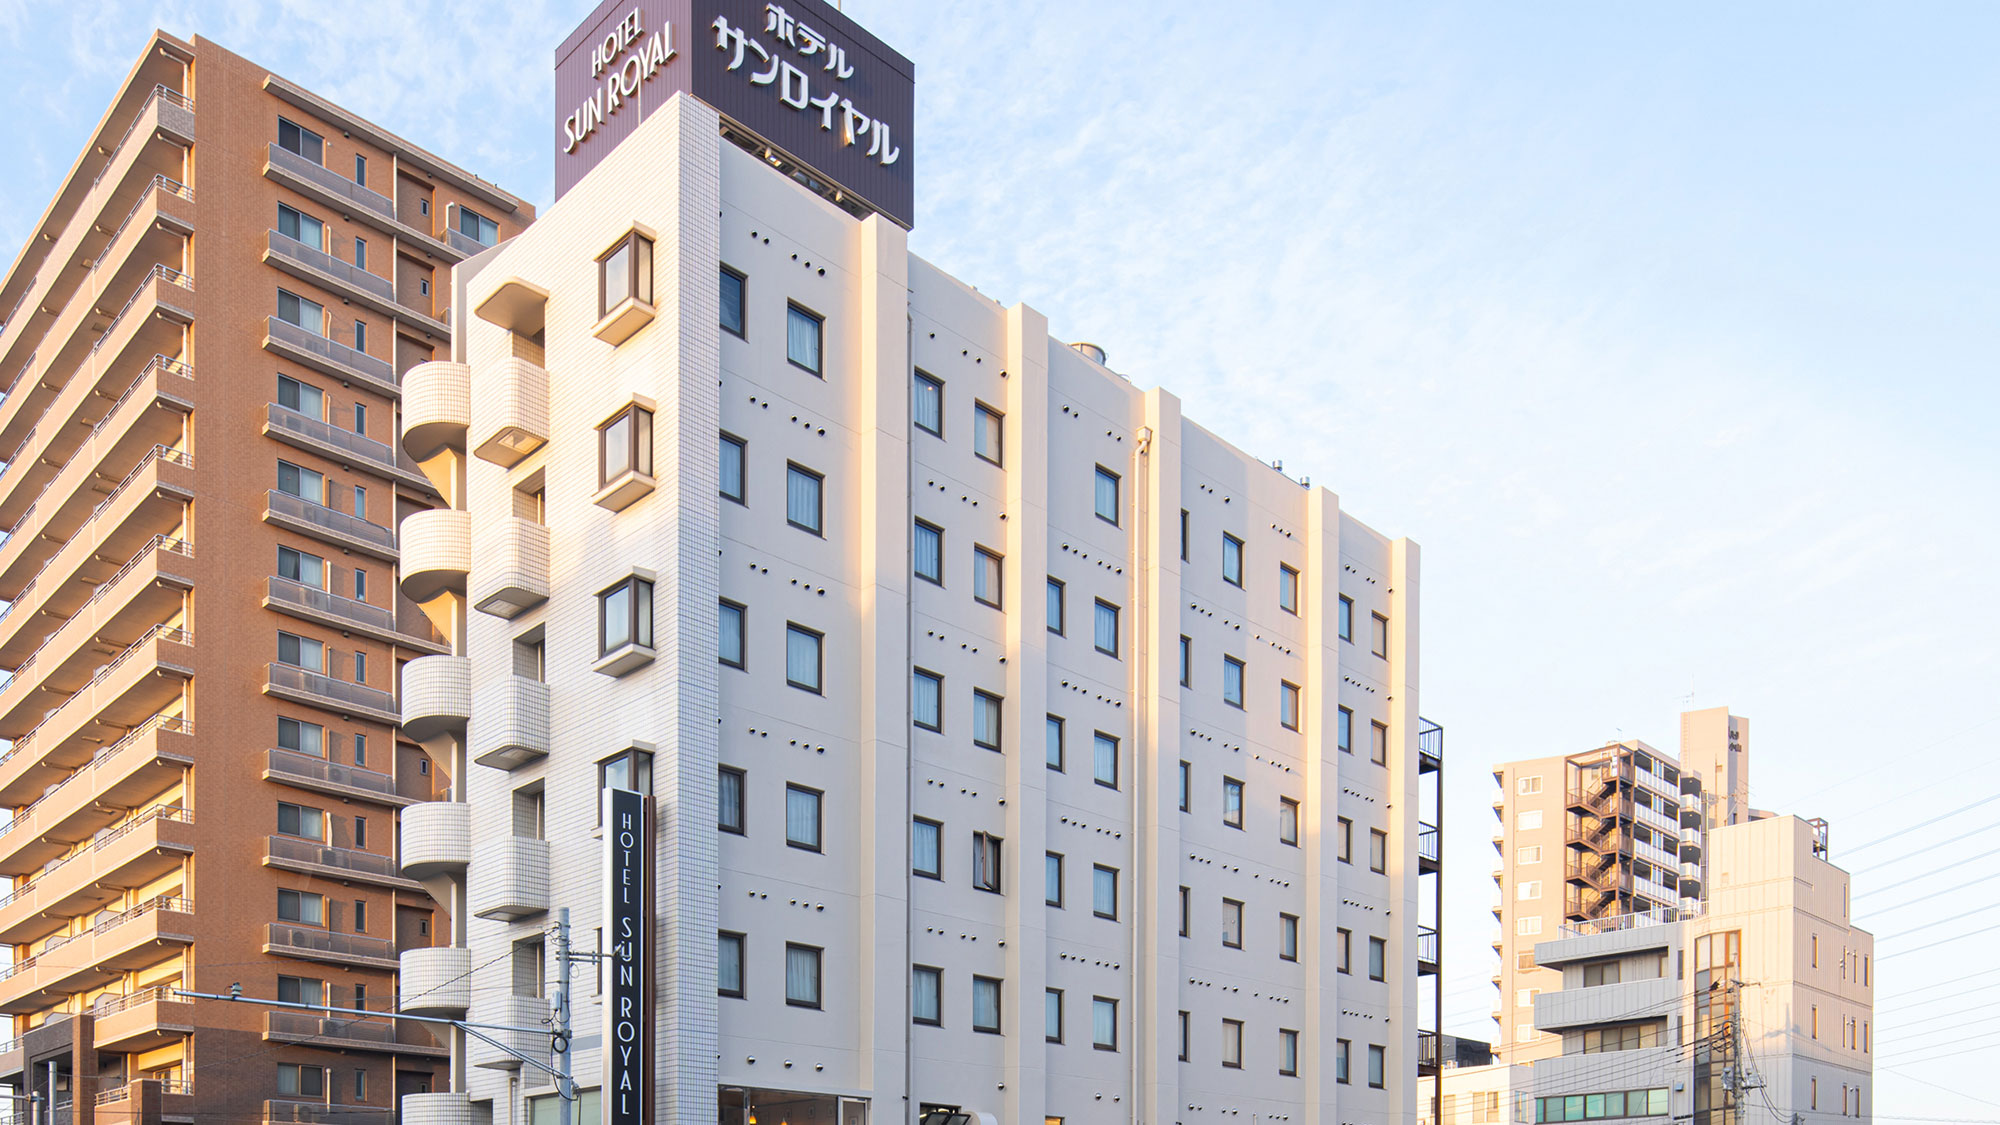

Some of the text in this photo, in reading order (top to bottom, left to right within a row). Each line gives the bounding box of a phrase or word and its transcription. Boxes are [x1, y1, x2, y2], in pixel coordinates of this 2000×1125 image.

[563, 20, 678, 154] SUN ROYAL
[591, 7, 644, 80] HOTEL
[711, 14, 900, 165] サンロイヤル
[764, 2, 854, 79] ホテル
[617, 812, 635, 1116] HOTEL SUN ROYAL
